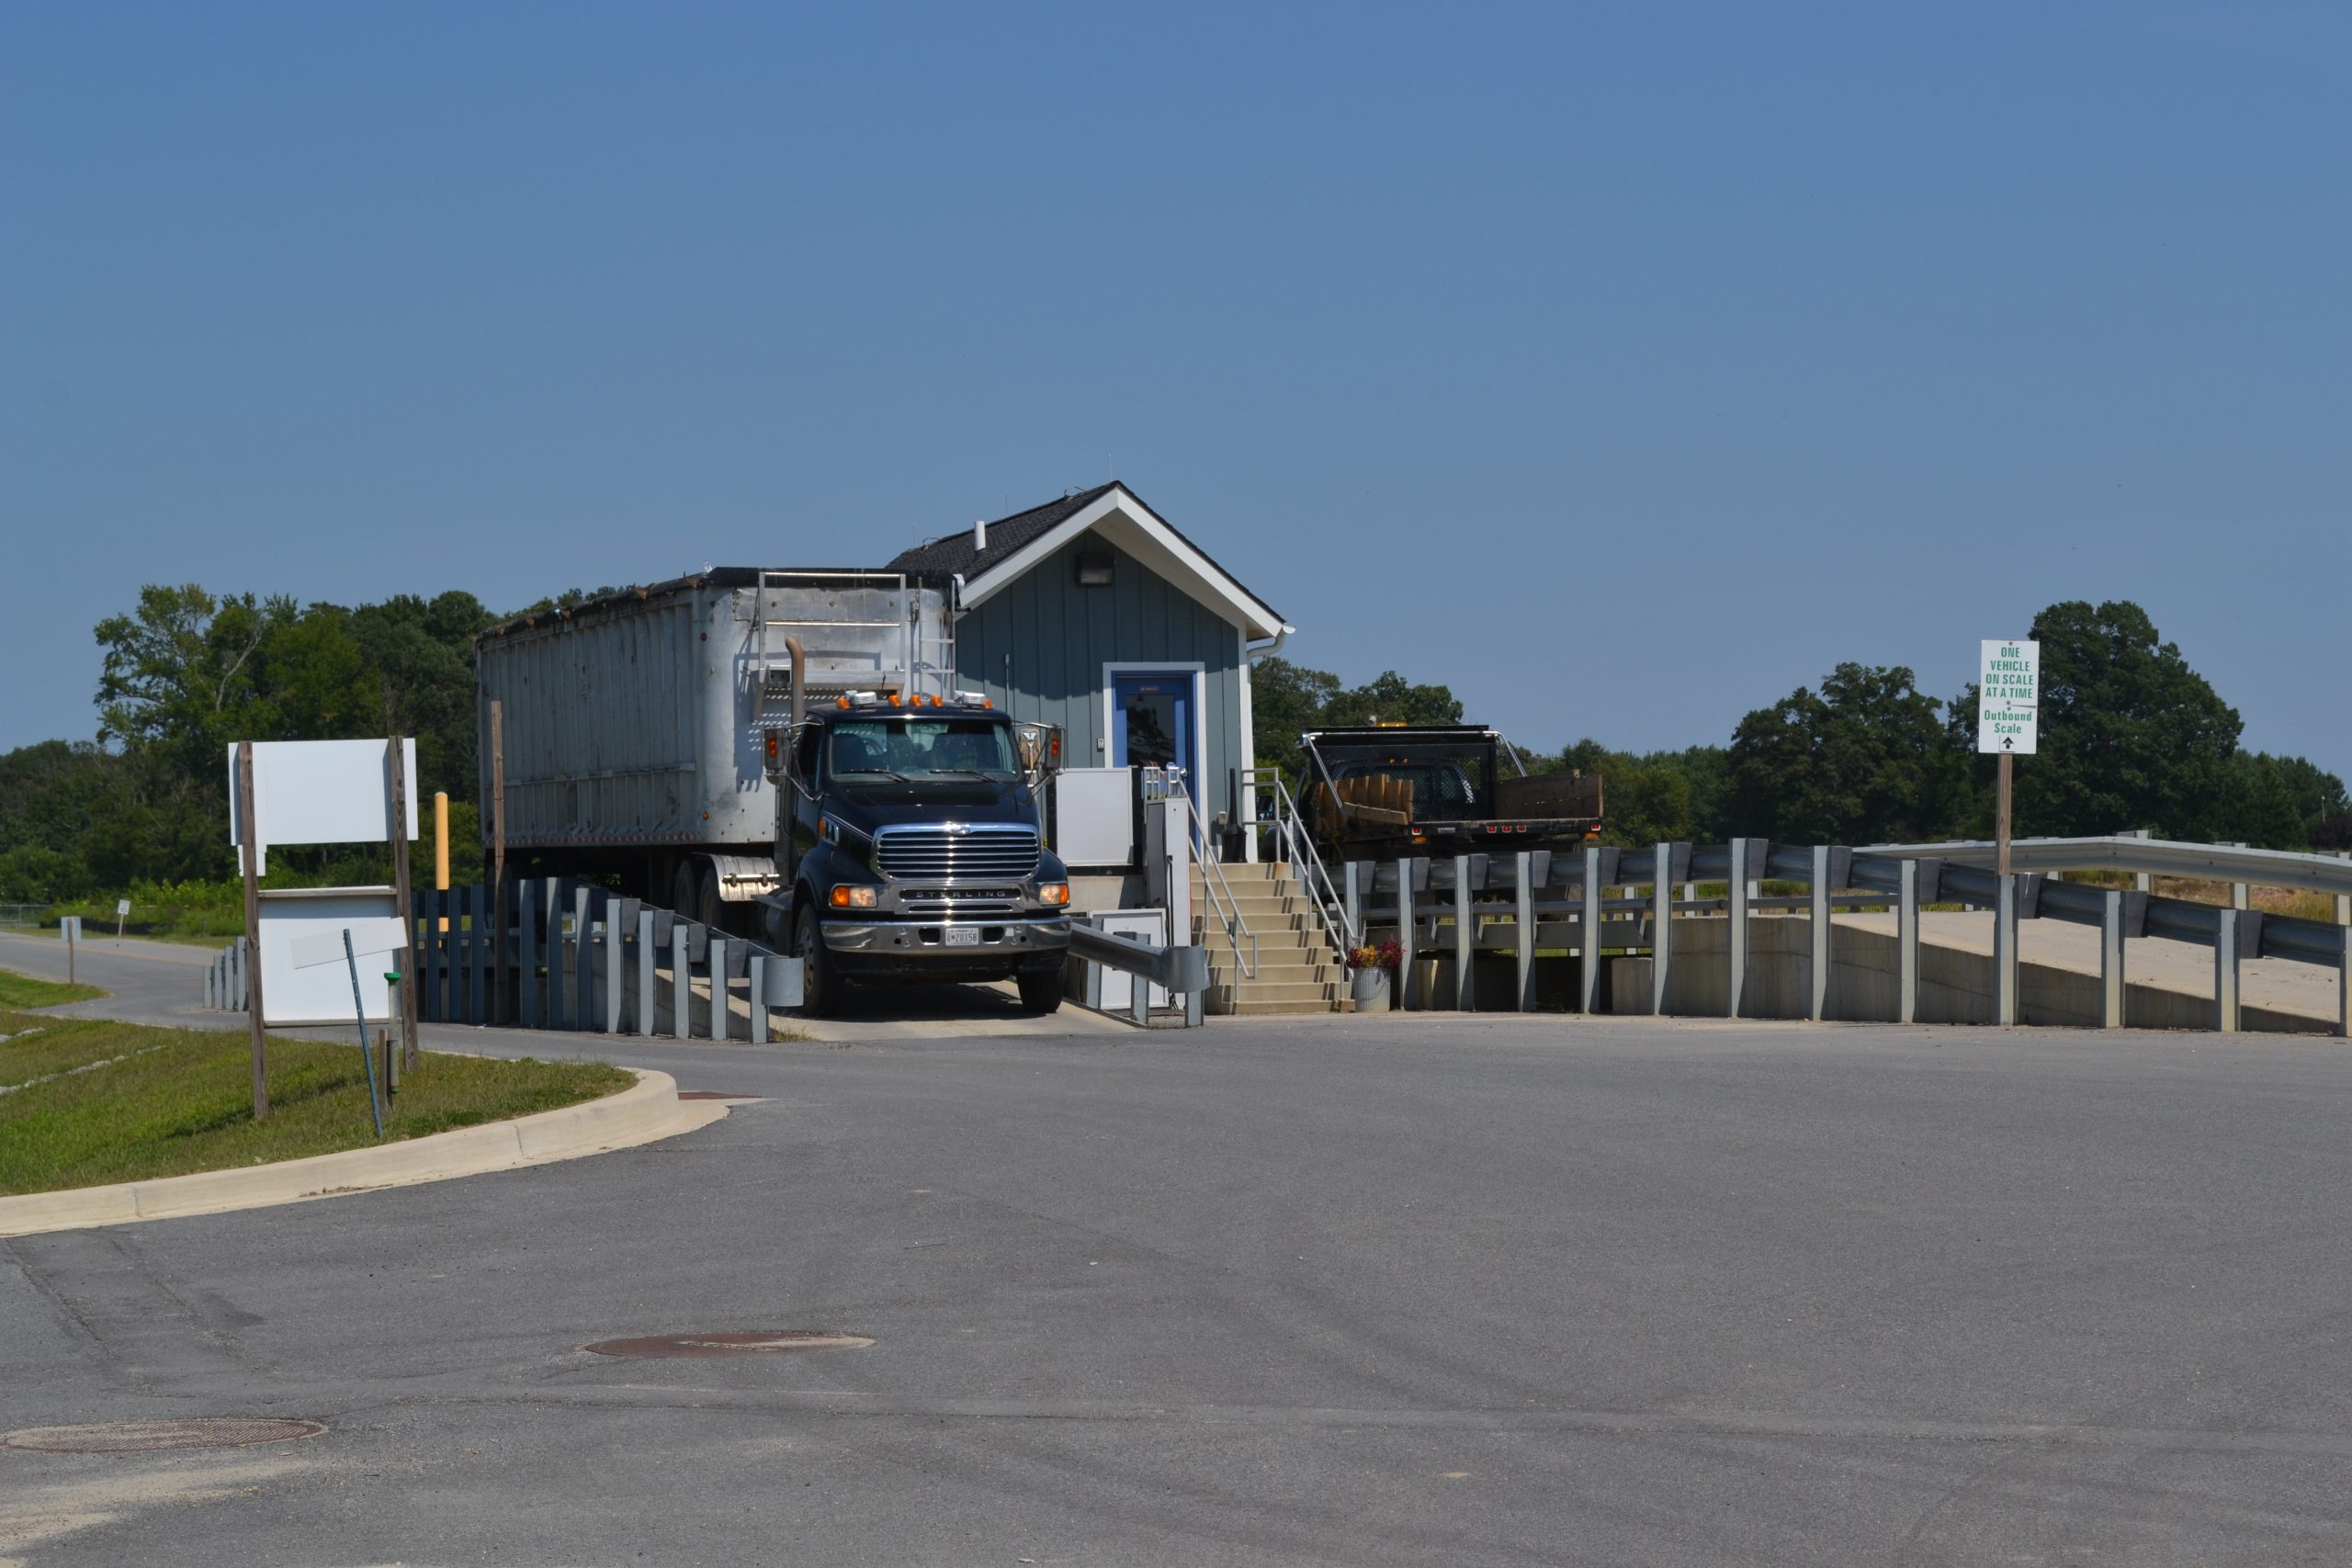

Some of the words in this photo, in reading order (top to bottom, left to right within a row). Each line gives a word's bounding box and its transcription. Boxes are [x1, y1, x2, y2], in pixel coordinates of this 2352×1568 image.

[2001, 647, 2020, 658] ONE
[1990, 660, 2030, 671] VEHICLE
[1985, 673, 1999, 684] ON
[2003, 674, 2034, 685] SCALE
[1985, 687, 1998, 698] AT
[2000, 687, 2007, 698] A
[2009, 687, 2032, 699] TIME
[1984, 709, 2032, 721] Outbound
[1995, 723, 2022, 734] Scale
[915, 890, 1006, 898] STERLING
